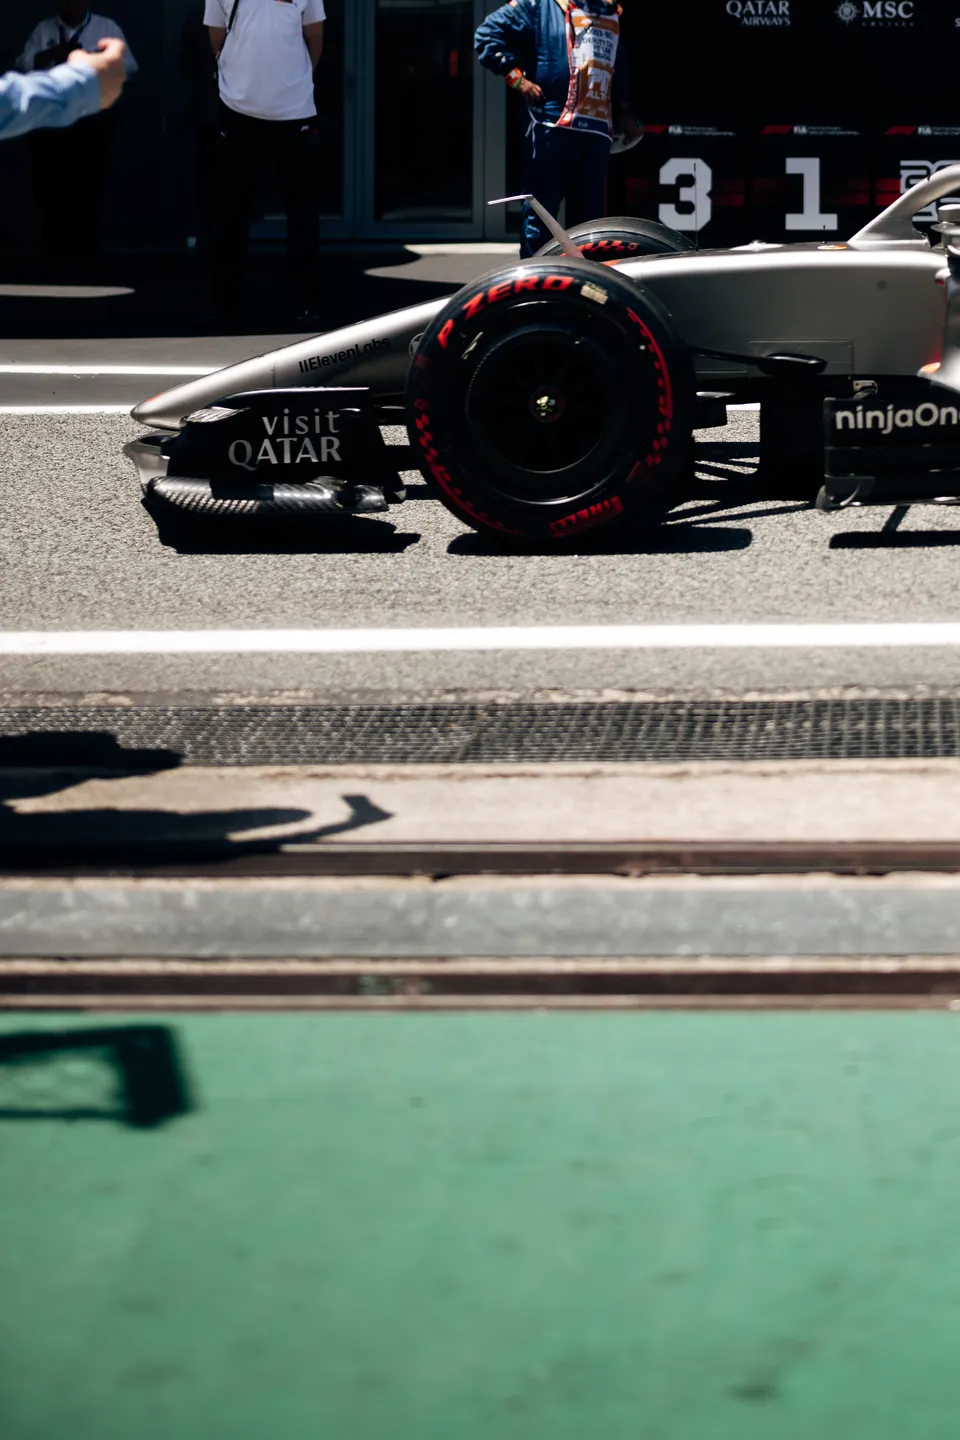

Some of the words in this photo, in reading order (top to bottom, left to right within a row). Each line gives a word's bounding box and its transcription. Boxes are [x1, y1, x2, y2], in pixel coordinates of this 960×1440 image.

[725, 0, 791, 19] QATAR
[740, 16, 792, 27] AIRWAYS
[862, 0, 914, 20] MSC
[658, 158, 713, 232] 3
[785, 157, 838, 231] 1
[463, 275, 575, 322] ZERO
[262, 407, 342, 436] visit
[228, 437, 342, 471] QATAR
